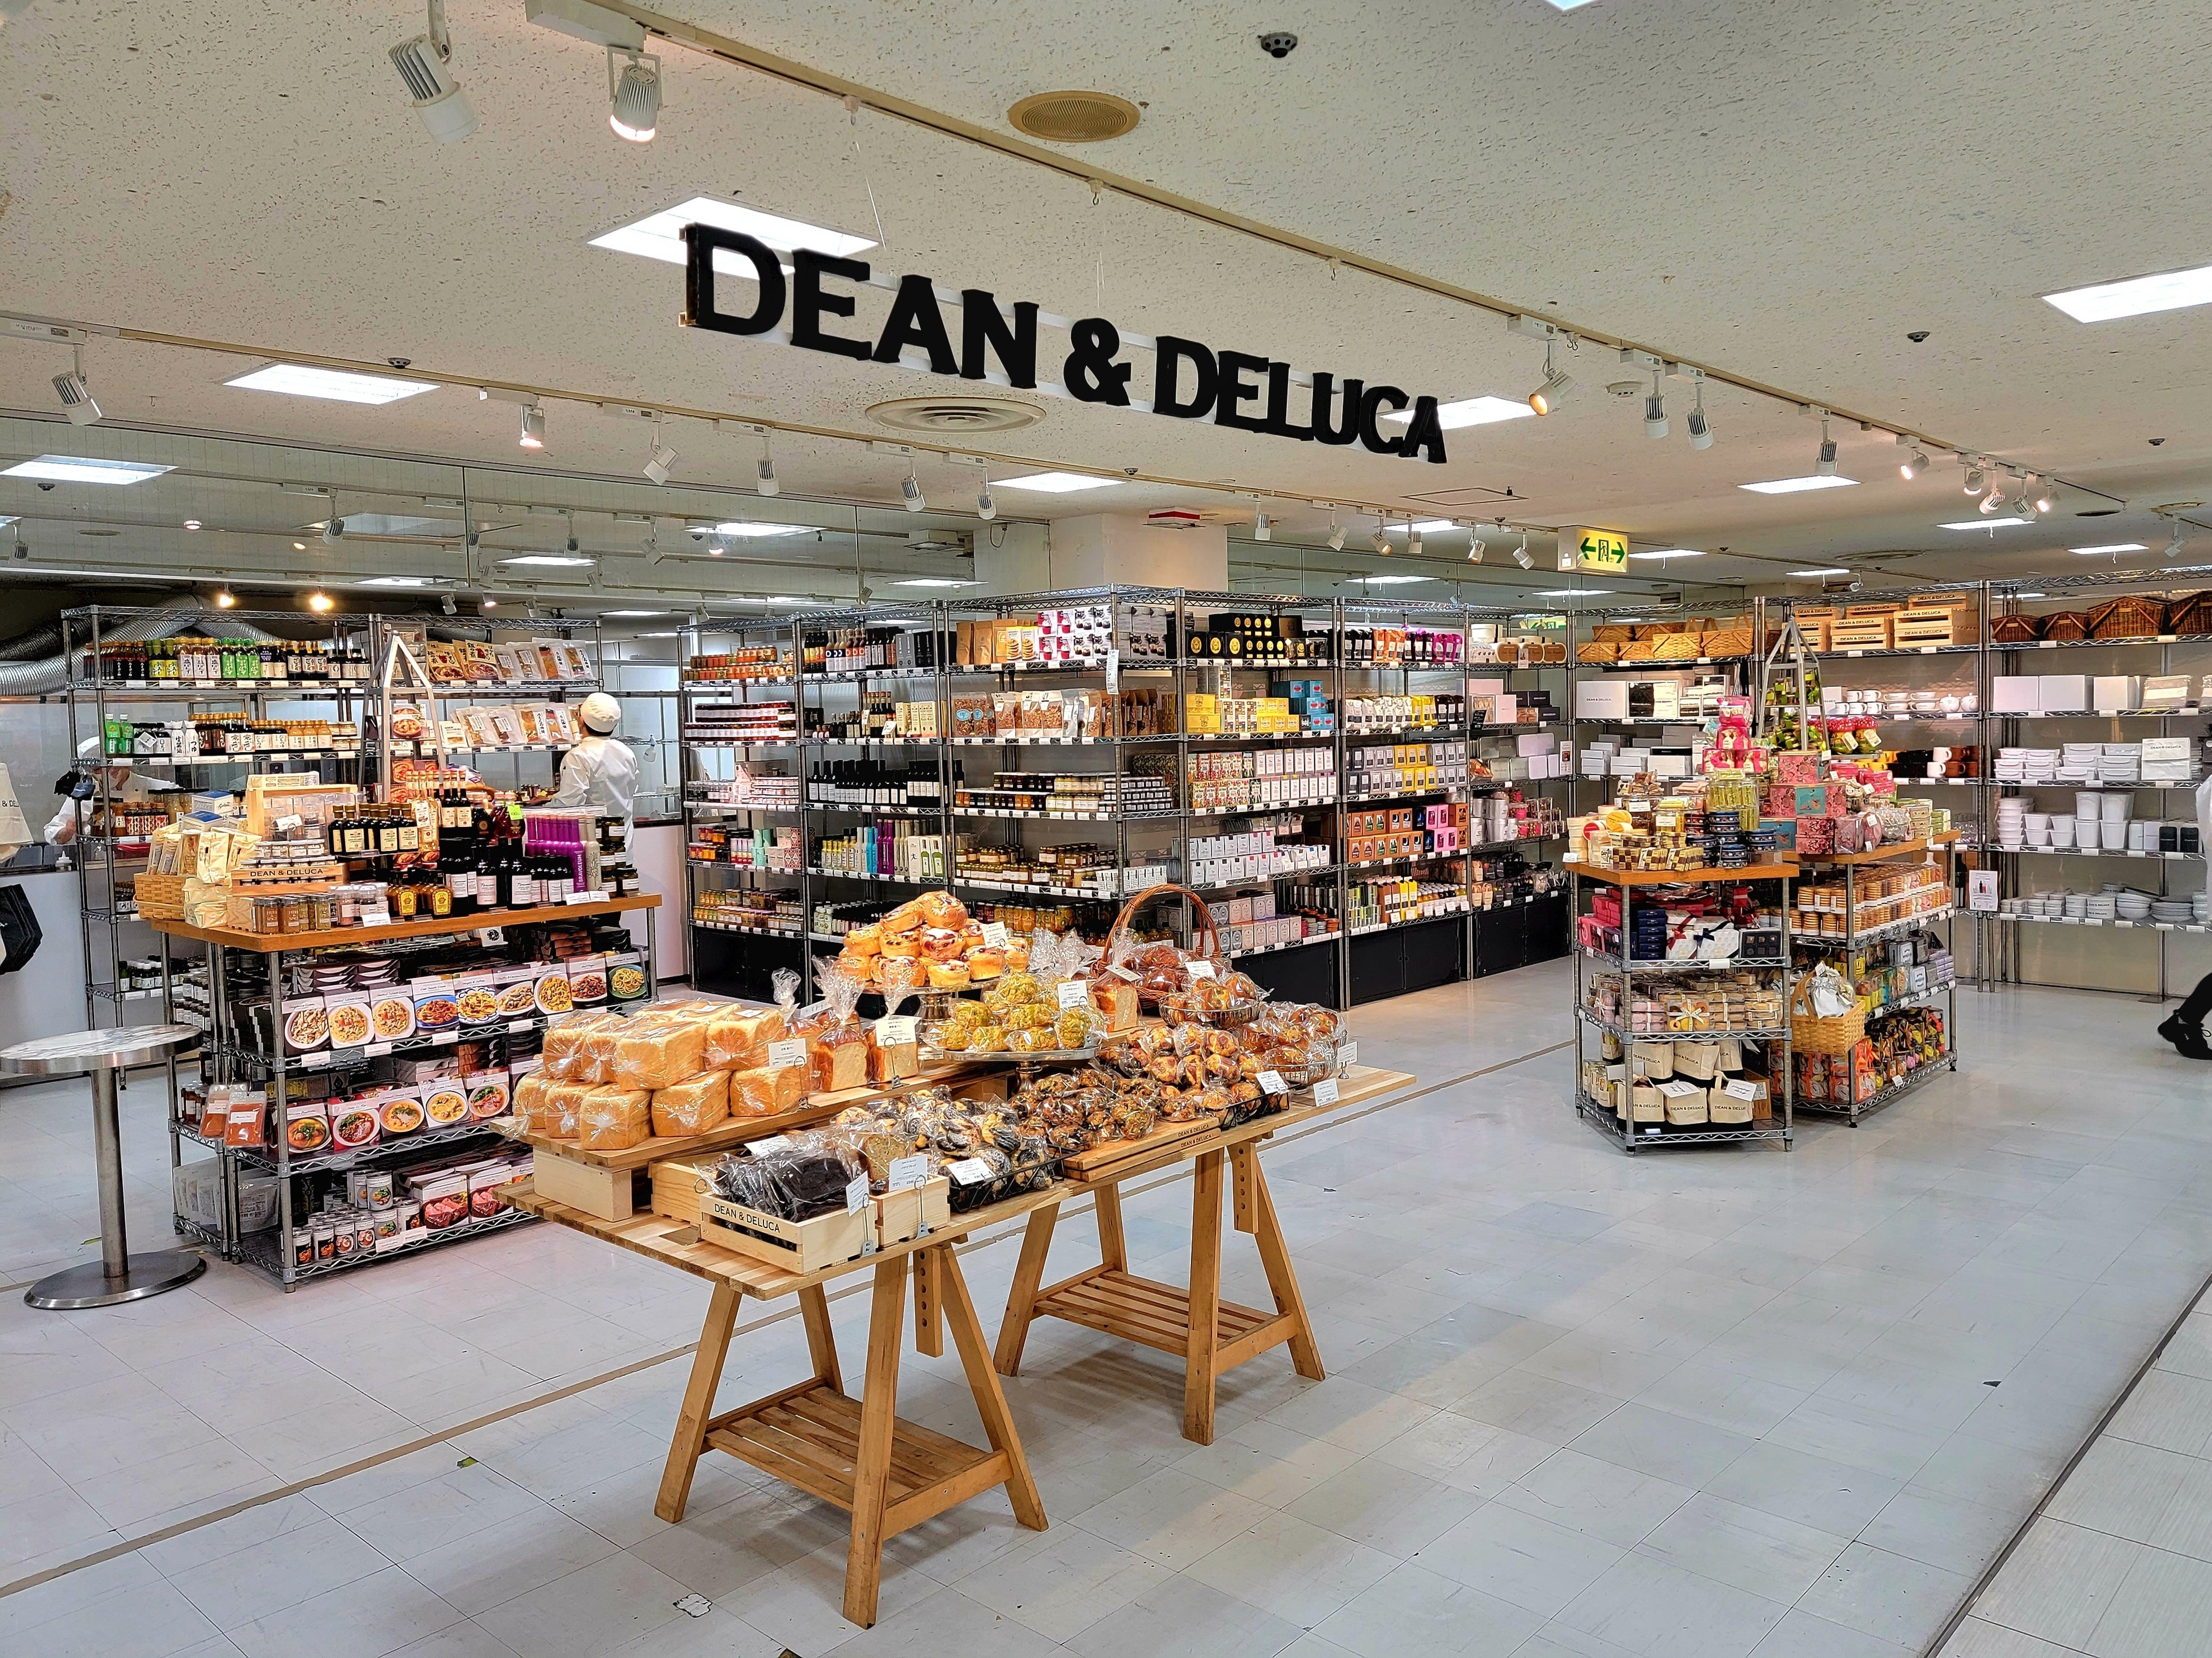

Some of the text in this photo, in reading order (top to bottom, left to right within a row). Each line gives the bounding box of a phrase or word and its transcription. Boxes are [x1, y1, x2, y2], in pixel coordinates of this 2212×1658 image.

[685, 222, 1447, 463] DEAN & DELUCA
[1684, 1056, 1699, 1065] DELUCA
[1196, 1134, 1211, 1143] DELUCA
[714, 1203, 780, 1234] DEAN & DELUCA
